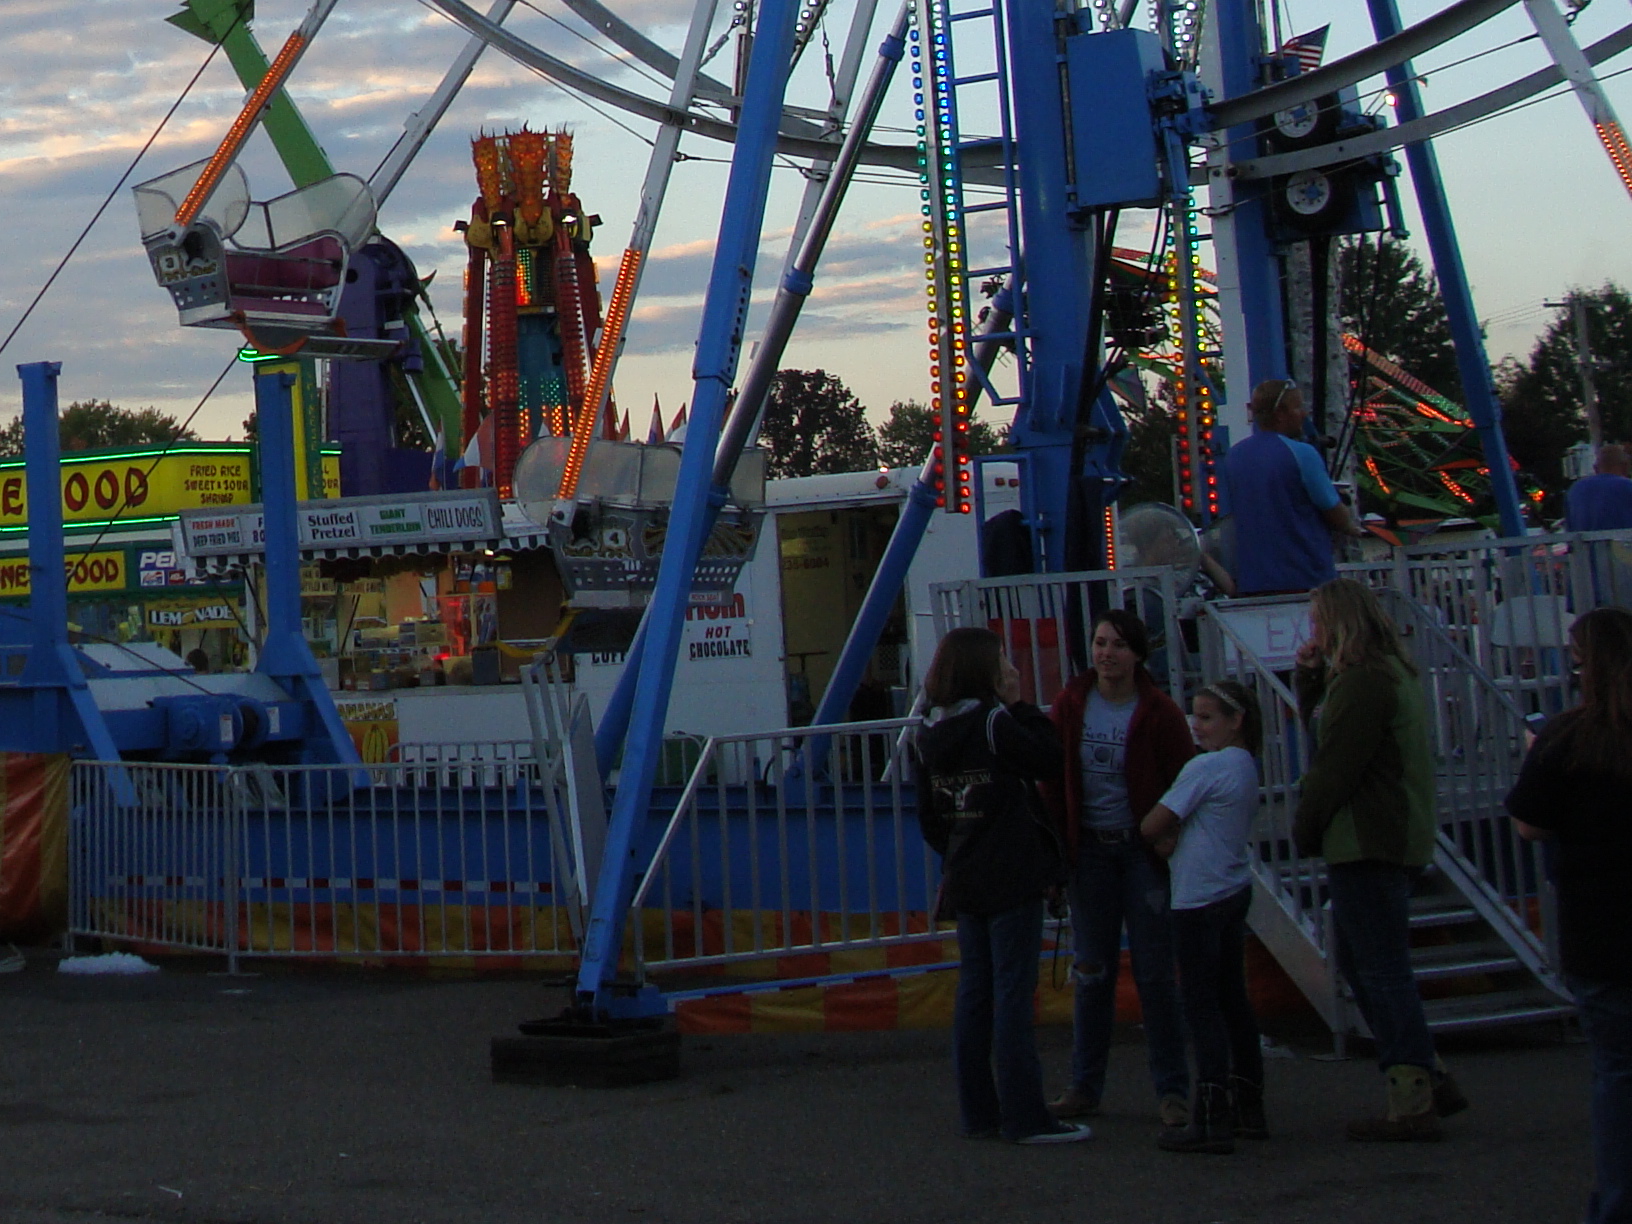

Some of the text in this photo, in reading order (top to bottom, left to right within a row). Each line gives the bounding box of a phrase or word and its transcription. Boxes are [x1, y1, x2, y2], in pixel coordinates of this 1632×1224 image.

[190, 464, 241, 477] FRIED RICE
[64, 466, 149, 513] OOD
[184, 479, 214, 492] SWEET
[224, 478, 249, 492] SOUR
[192, 519, 235, 530] FRESH MADE
[308, 512, 354, 527] Stuffed
[428, 506, 483, 529] CHILI DOGS
[312, 526, 356, 540] Pretzel
[705, 626, 731, 639] HOT
[689, 639, 750, 659] CHOCOLATE
